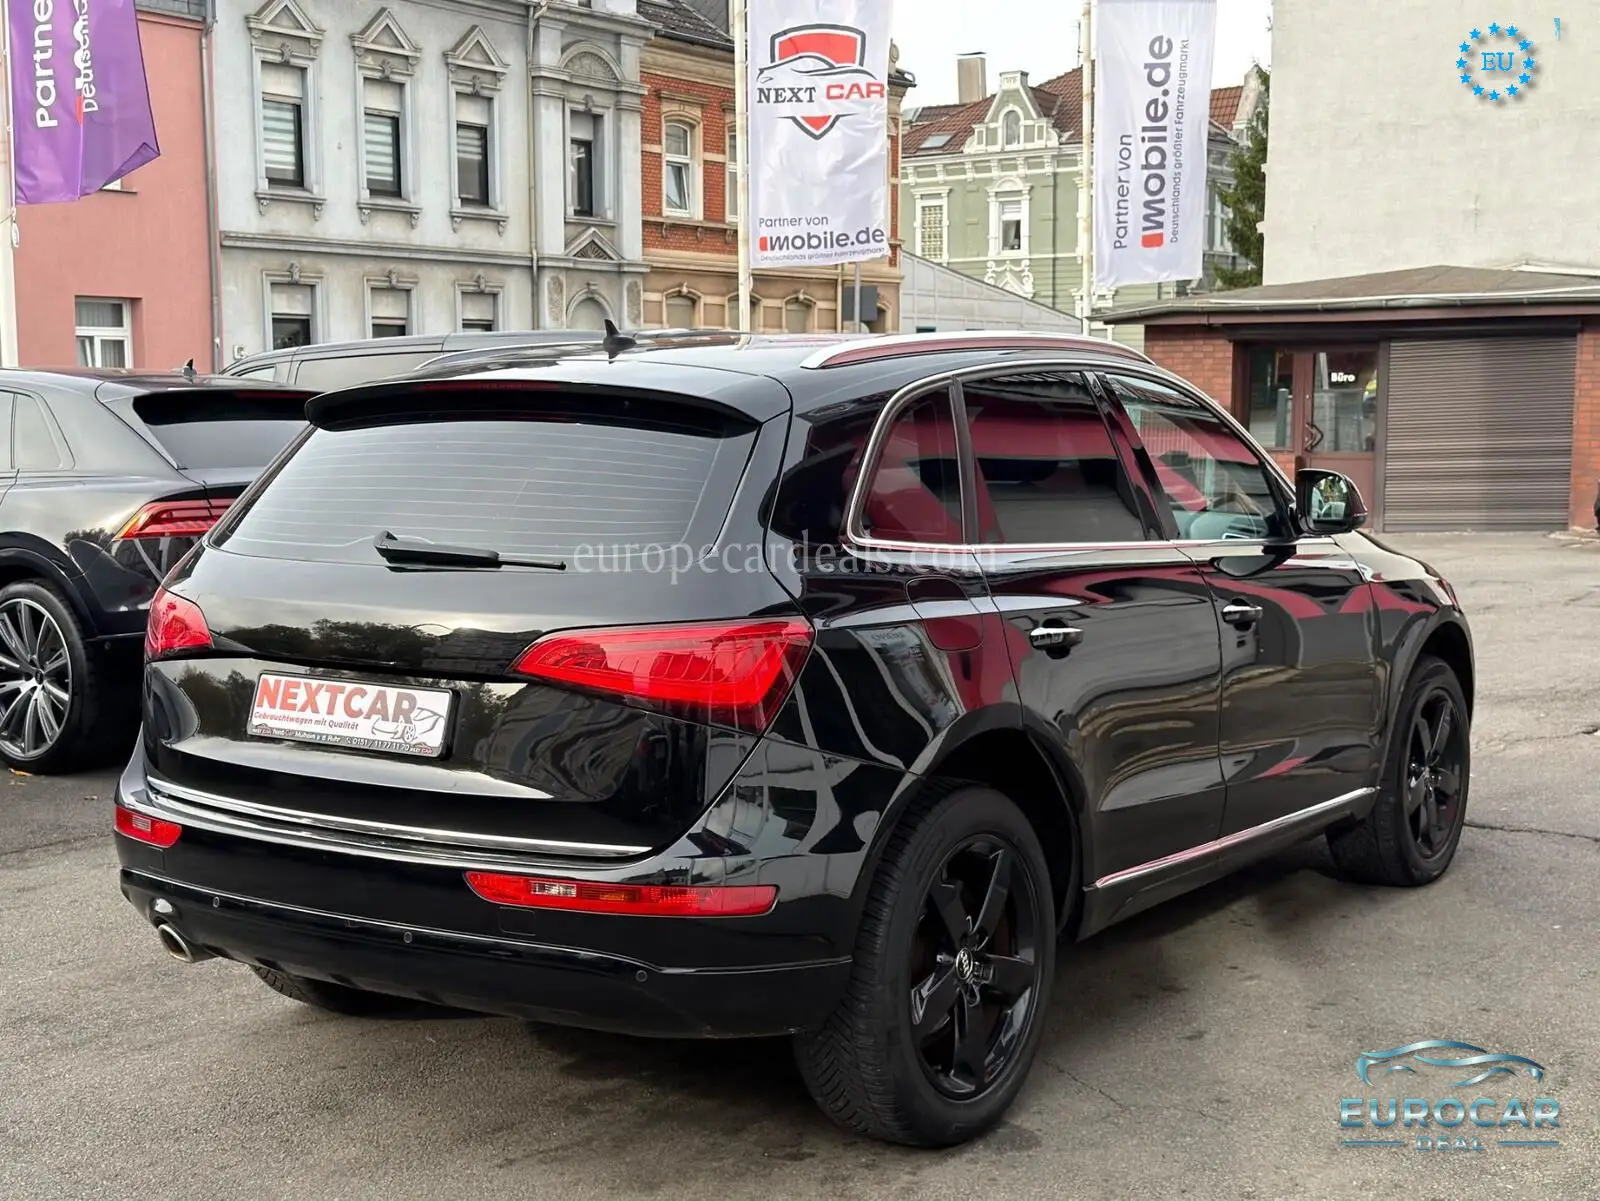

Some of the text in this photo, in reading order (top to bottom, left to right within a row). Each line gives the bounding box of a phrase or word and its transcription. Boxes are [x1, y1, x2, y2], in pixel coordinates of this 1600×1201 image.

[756, 82, 885, 104] NEXT CAR
[1174, 39, 1189, 125] Fahrzeugmarkt
[1141, 35, 1173, 232] mobile.de
[1114, 134, 1132, 249] Partner von
[1170, 171, 1182, 243] Deutschlands
[759, 216, 828, 228] Partner von
[769, 226, 885, 251] mobile.de
[1330, 372, 1355, 383] Büro
[256, 677, 418, 725] NEXTCAR
[253, 711, 359, 731] Gebrauchtwagen mit Qualität
